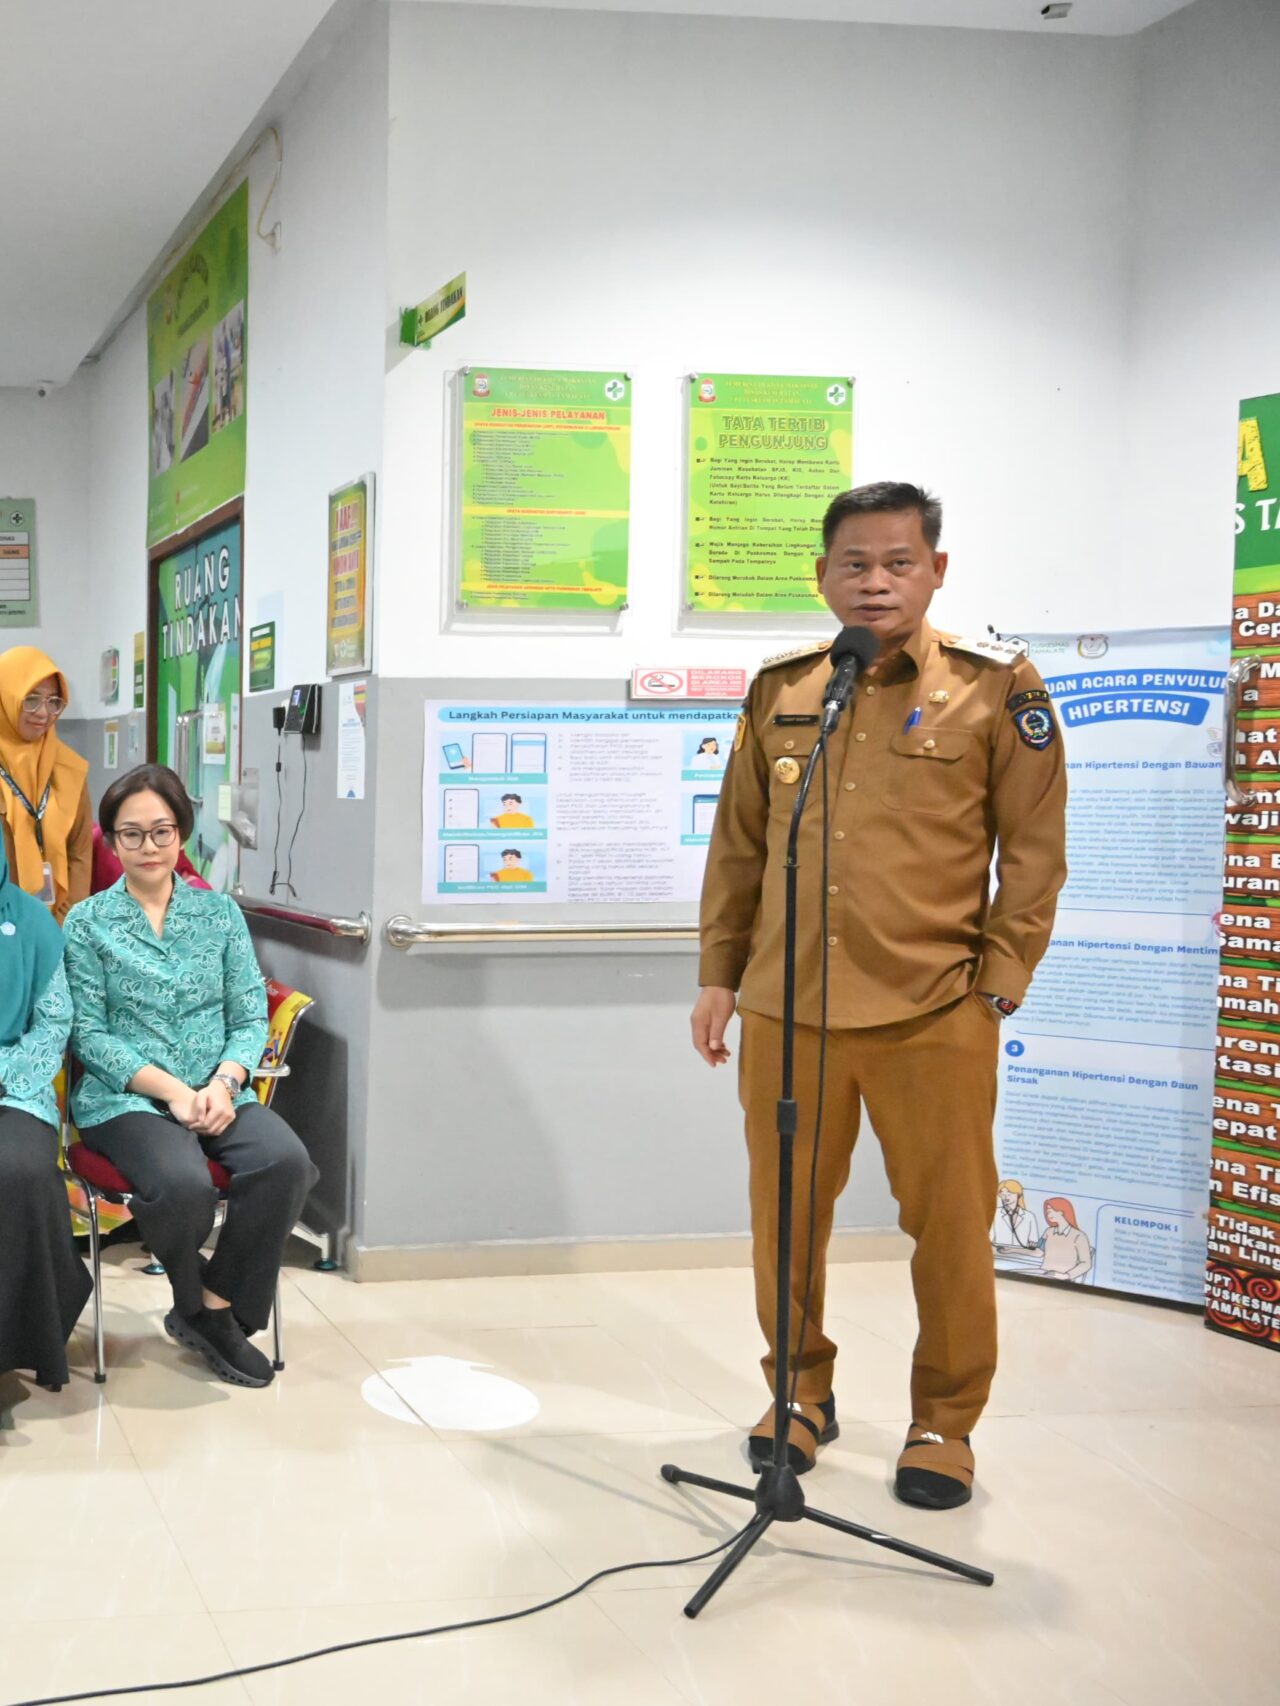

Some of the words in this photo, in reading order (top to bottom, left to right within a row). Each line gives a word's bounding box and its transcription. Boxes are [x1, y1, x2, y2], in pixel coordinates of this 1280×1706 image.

[491, 409, 547, 417] JENIS-JENIS
[551, 411, 605, 420] PELAYANAN
[722, 416, 765, 430] TATA
[768, 417, 825, 432] TERTIB
[719, 434, 828, 449] PENGUNJUNG
[175, 548, 230, 609] RUANG
[1082, 674, 1137, 689] ACARA
[449, 711, 498, 721] Langkah
[500, 711, 559, 720] Persiapan
[562, 711, 629, 721] Masyarakat
[632, 711, 665, 720] untuk
[1068, 699, 1191, 720] HIPERTENSI
[1257, 749, 1280, 765] A
[1085, 761, 1139, 770] Hipertensi
[1142, 762, 1181, 770] Dengan
[1224, 854, 1261, 867] na
[1078, 940, 1131, 949] Hipertensi
[1134, 943, 1173, 954] Dengan
[1007, 1064, 1070, 1078] Penanganan
[1072, 1070, 1125, 1084] Hipertensi
[1128, 1076, 1168, 1088] Dengan
[1171, 1080, 1199, 1091] Daun
[1007, 1075, 1039, 1085] Sirsak
[1114, 1216, 1171, 1231] KELOMPOK
[1216, 1214, 1275, 1240] Tidak
[1209, 1226, 1280, 1254] judkan
[1205, 1271, 1231, 1287] UPT
[1205, 1298, 1280, 1329] TAMALATE
